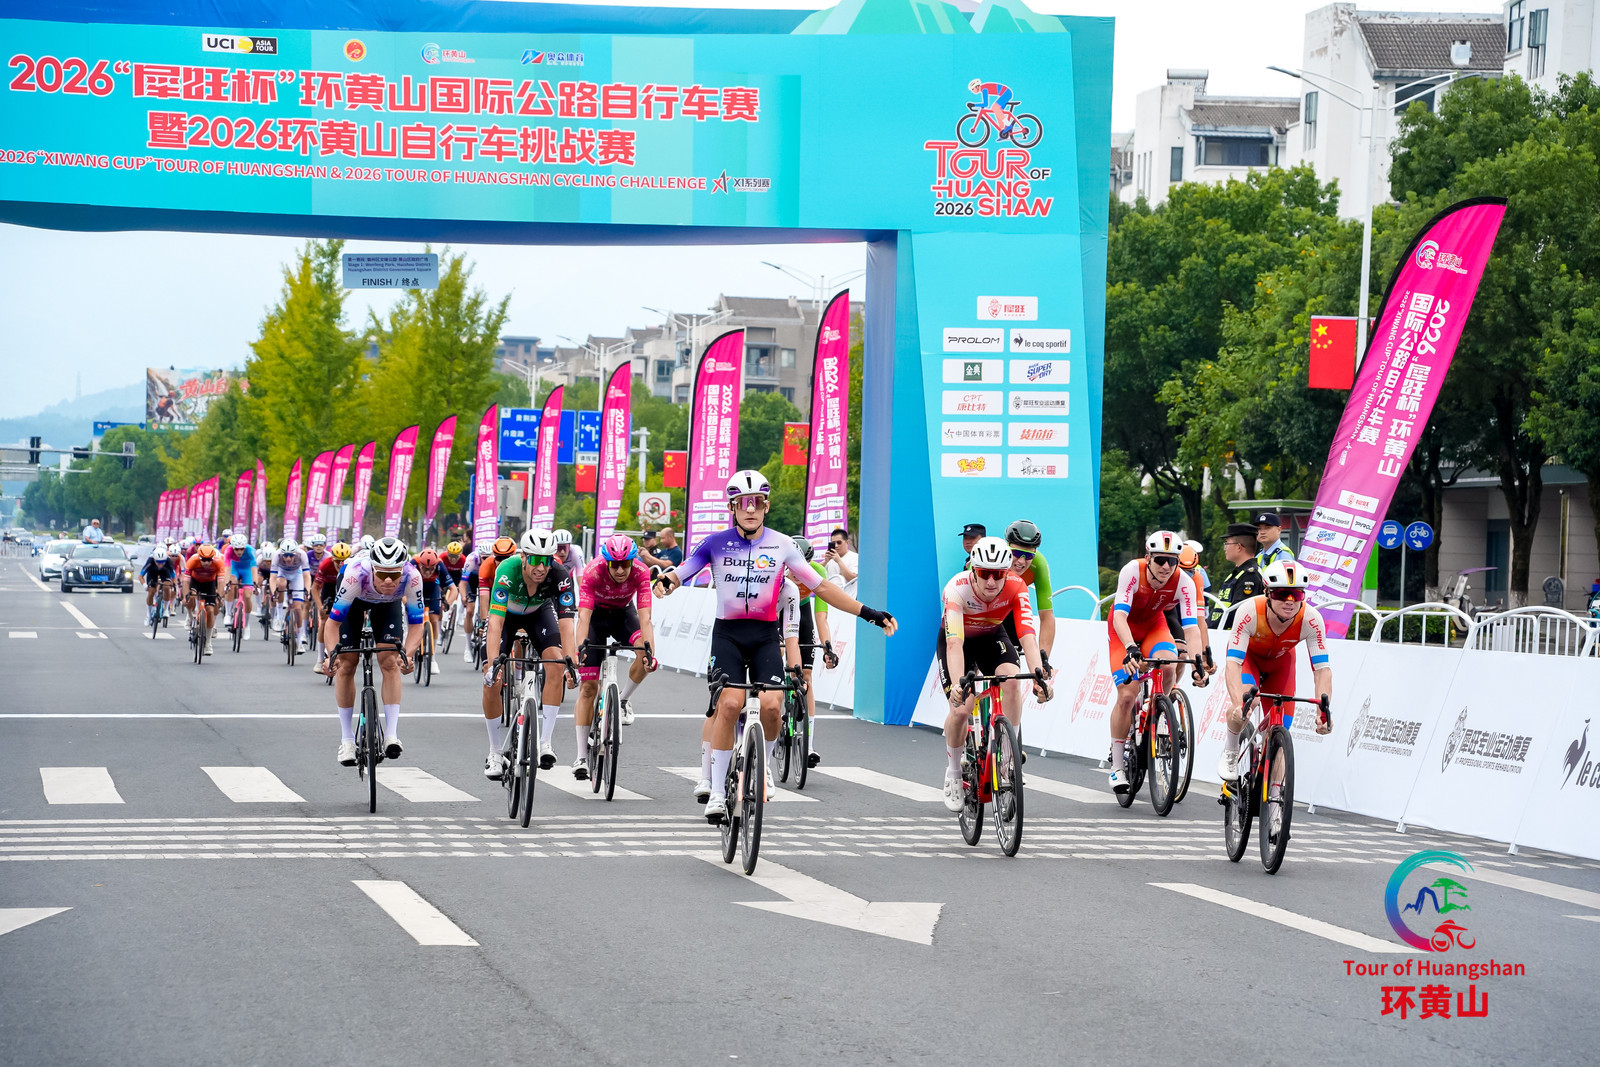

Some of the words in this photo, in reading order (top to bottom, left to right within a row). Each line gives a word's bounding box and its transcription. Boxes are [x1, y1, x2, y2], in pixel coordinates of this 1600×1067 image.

[206, 37, 235, 50] UCI
[255, 45, 274, 53] TOUR
[442, 49, 467, 59] 环黄山
[547, 52, 585, 62] 奥众体育
[147, 111, 636, 167] 暨2026环黄山自行车挑战赛
[925, 140, 1031, 180] TOUR
[1030, 169, 1051, 180] OF
[202, 160, 224, 175] OF
[227, 161, 328, 180] HUANGSHAN
[330, 166, 343, 179] &
[344, 166, 382, 182] 2026
[384, 168, 428, 184] TOUR
[431, 169, 452, 184] OF
[454, 170, 551, 188] HUANGSHAN
[553, 172, 617, 189] CYCLING
[619, 174, 707, 191] CHALLENGE
[931, 179, 1032, 199] HUANG
[935, 202, 974, 216] 2026
[977, 197, 1054, 217] SHAN
[362, 278, 392, 286] FINISH
[402, 278, 419, 286] 终点
[948, 336, 1000, 344] PROLOM
[1032, 341, 1044, 349] coq
[1045, 340, 1067, 349] sportif
[1027, 362, 1052, 378] SUPER
[1357, 292, 1435, 446] 国际公路自行车赛
[963, 394, 983, 402] CPT
[1371, 383, 1379, 393] OF
[957, 402, 987, 411] 康比特
[1350, 393, 1375, 440] HUANGSHAN
[955, 430, 1000, 438] 中国体育彩票
[956, 578, 968, 586] ANTA
[1123, 576, 1137, 603] LI-NING
[1018, 592, 1036, 629] ANTA
[1181, 586, 1192, 617] LI-NING
[1233, 613, 1252, 646] LI-NING
[1308, 618, 1326, 650] LI-NING
[1362, 715, 1422, 746] 犀旺专业运动康复
[1459, 728, 1533, 762] 犀旺专业运动康复
[1576, 750, 1593, 787] le
